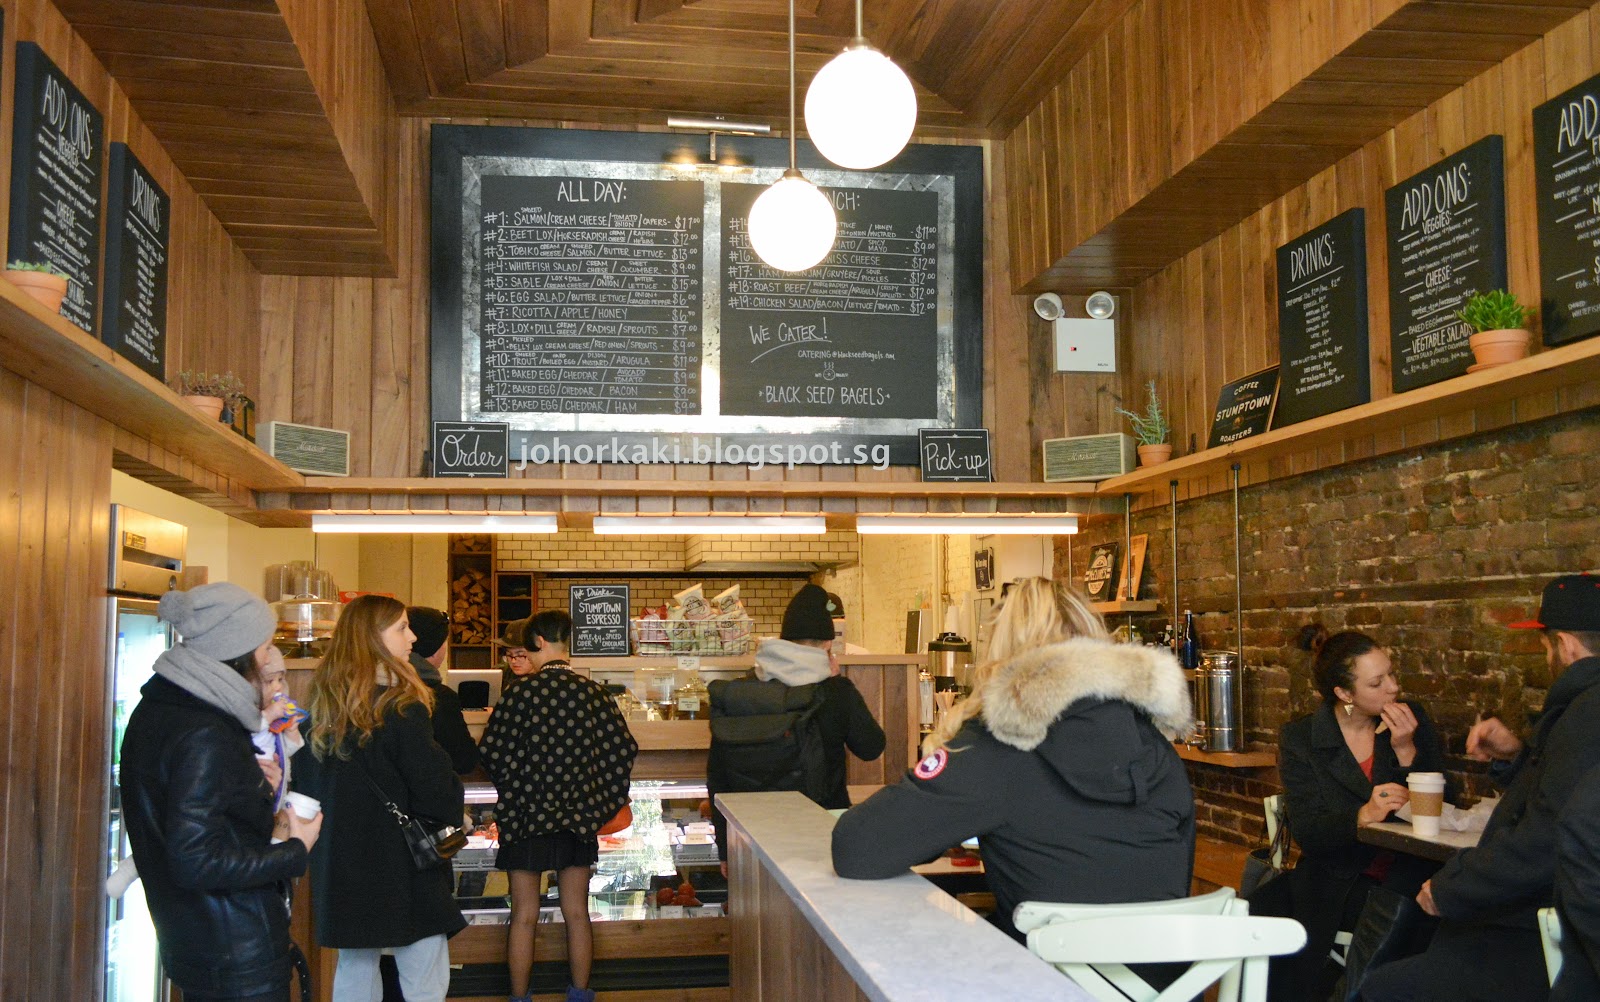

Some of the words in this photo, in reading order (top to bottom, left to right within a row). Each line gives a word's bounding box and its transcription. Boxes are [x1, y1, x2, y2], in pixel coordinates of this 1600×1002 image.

[43, 75, 67, 133] ADD
[1558, 95, 1597, 153] ADD
[558, 181, 589, 203] ALL
[595, 182, 627, 203] DAY:
[1401, 183, 1431, 230] ADD
[1435, 162, 1471, 213] ONS:
[510, 229, 534, 240] BEET
[508, 245, 539, 256] TOBIKO
[851, 256, 880, 265] CHEESE
[1291, 233, 1335, 282] DRINKS:
[509, 262, 550, 272] WHITEFISH
[620, 266, 661, 274] CUCUMBER
[1425, 264, 1452, 288] CHEESE:
[511, 277, 541, 288] SABLE
[597, 279, 619, 287] ONION
[754, 282, 781, 292] ROAST
[510, 291, 529, 303] EGG
[753, 297, 785, 307] CHICKEN
[512, 307, 552, 318] RICOTTA
[561, 308, 589, 318] APPLE
[598, 308, 627, 319] HONEY
[511, 323, 529, 333] LOX
[535, 324, 555, 334] DILL
[587, 324, 615, 334] RADISH
[749, 326, 770, 345] WE
[616, 356, 651, 366] ARUGULA
[512, 370, 537, 379] BAKED
[513, 385, 537, 394] BAKED
[610, 386, 638, 396] BACON
[1234, 381, 1259, 396] COFFEE
[766, 386, 800, 403] BLACK
[806, 386, 834, 404] SEED
[841, 387, 884, 405] BAGELS
[512, 399, 539, 410] BAKED
[615, 402, 637, 413] HAM
[1216, 394, 1271, 422] STUMPTOWN
[1220, 427, 1252, 442] ROASTERS
[441, 434, 503, 467] Order
[579, 602, 621, 613] STUMPTOWN
[586, 614, 621, 624] ESPRESSO
